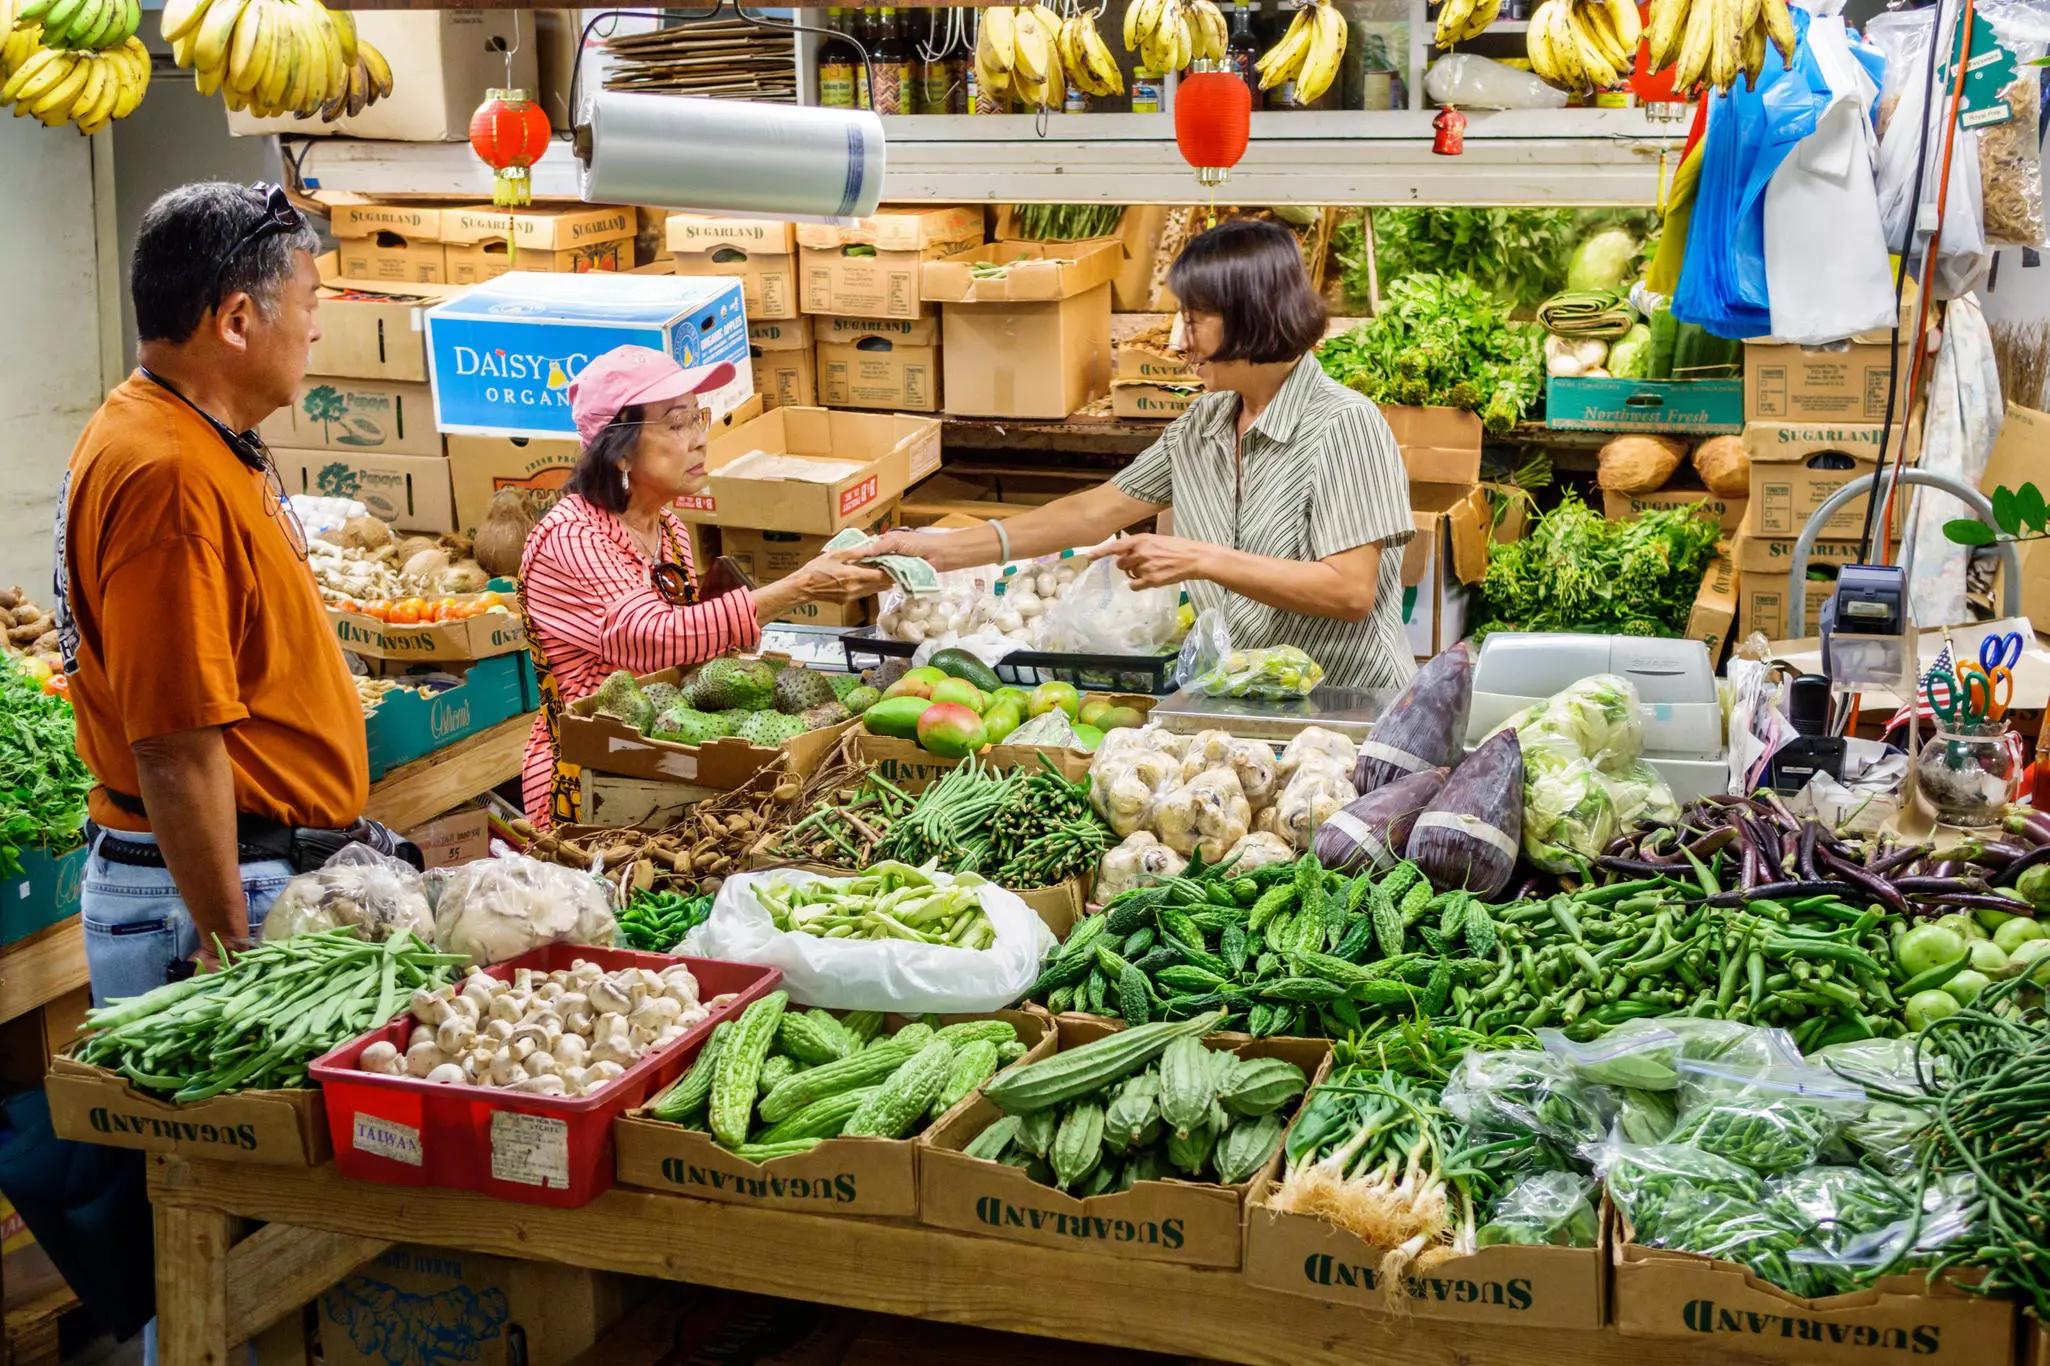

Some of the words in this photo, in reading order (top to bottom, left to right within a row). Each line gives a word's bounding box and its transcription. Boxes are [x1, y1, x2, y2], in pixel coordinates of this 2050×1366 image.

[350, 211, 421, 227] SUGARLAND
[572, 215, 626, 239] SUGARLAND
[686, 225, 764, 240] SUGARLAND
[833, 319, 911, 334] SUGARLAND
[453, 345, 545, 379] DAISY
[347, 391, 390, 412] Papaya
[486, 387, 571, 407] ORGAN
[1584, 406, 1661, 422] Northwest
[1667, 409, 1709, 423] Fresh
[359, 468, 402, 487] Papaya
[89, 1107, 258, 1150] SUGARLAND
[661, 1156, 857, 1203] SUGARLAND
[976, 1196, 1185, 1249] SUGARLAND
[1304, 1252, 1532, 1310] SUGARAND
[1683, 1299, 1941, 1355] SUGARLAND
